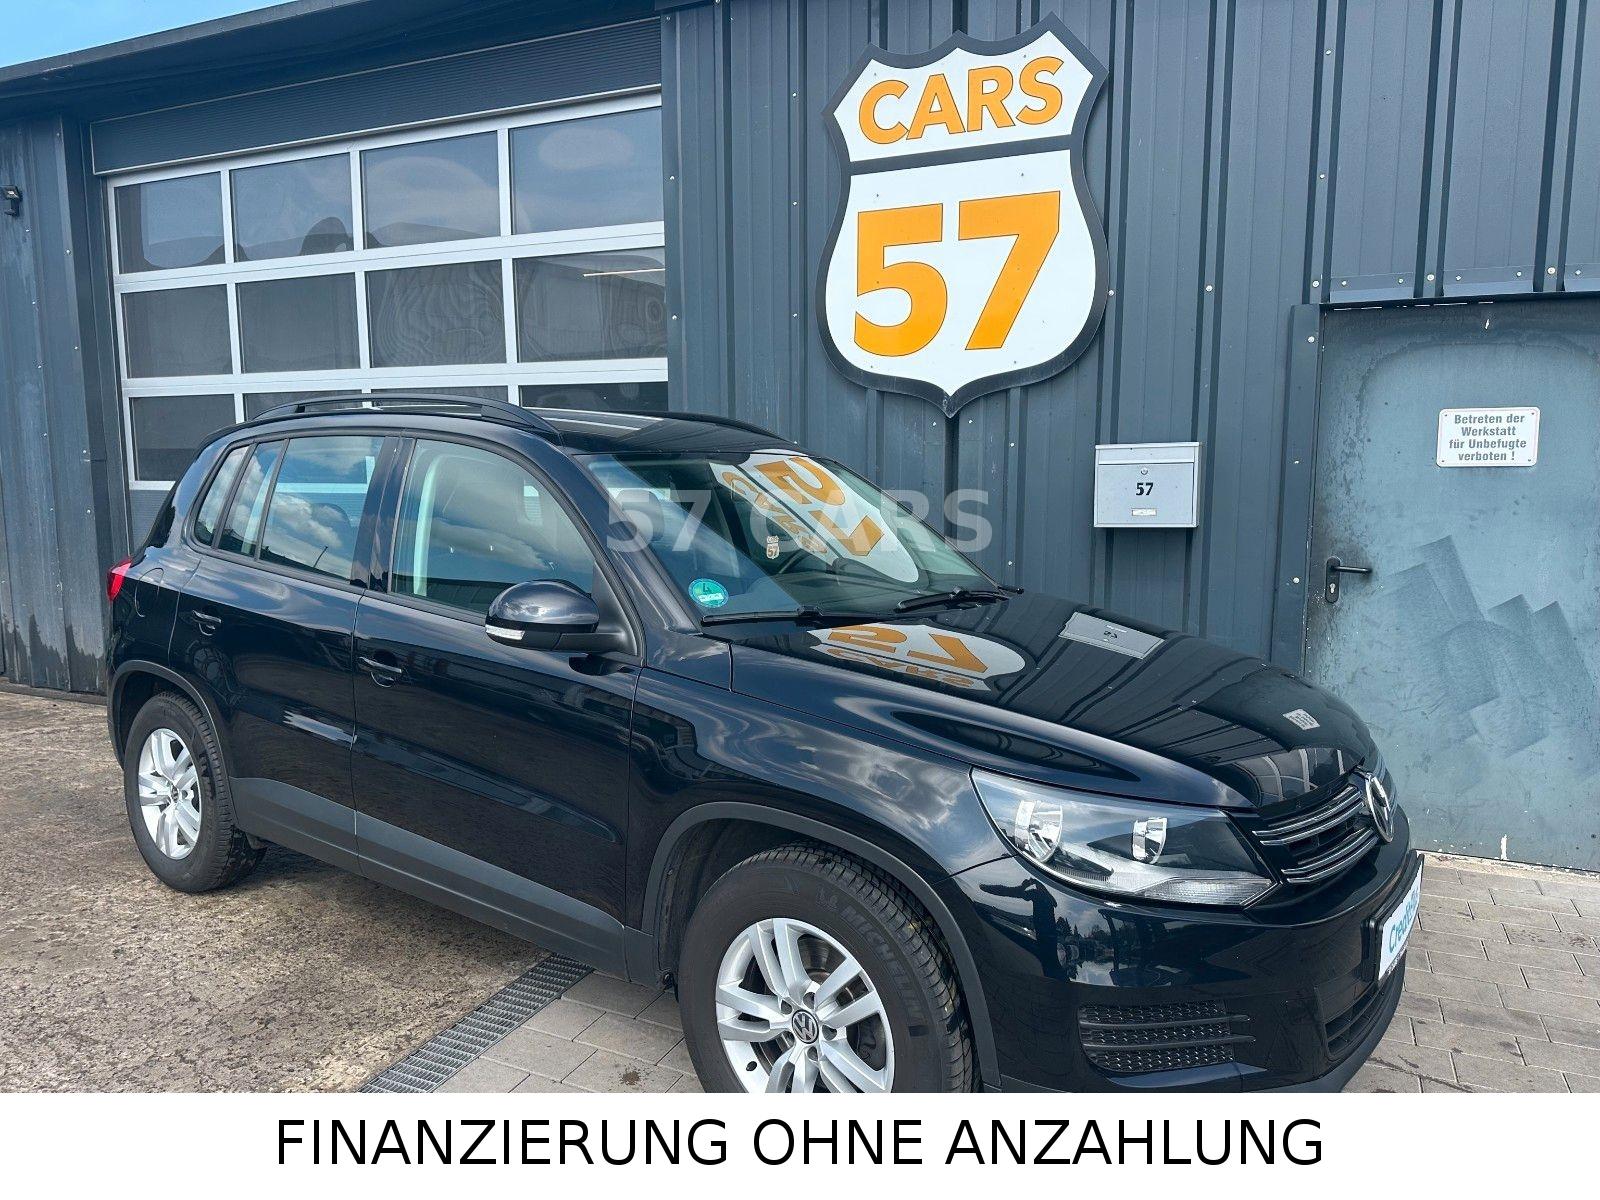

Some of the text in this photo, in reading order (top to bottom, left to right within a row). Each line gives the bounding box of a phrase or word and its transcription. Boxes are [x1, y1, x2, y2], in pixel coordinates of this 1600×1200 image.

[859, 55, 1064, 144] CARS
[854, 191, 1061, 356] 57
[1454, 414, 1525, 424] Betreten der
[1461, 426, 1516, 436] Werkstatt
[1449, 438, 1527, 450] für Unbefugte
[1458, 451, 1507, 461] verboten
[1136, 483, 1153, 495] 57
